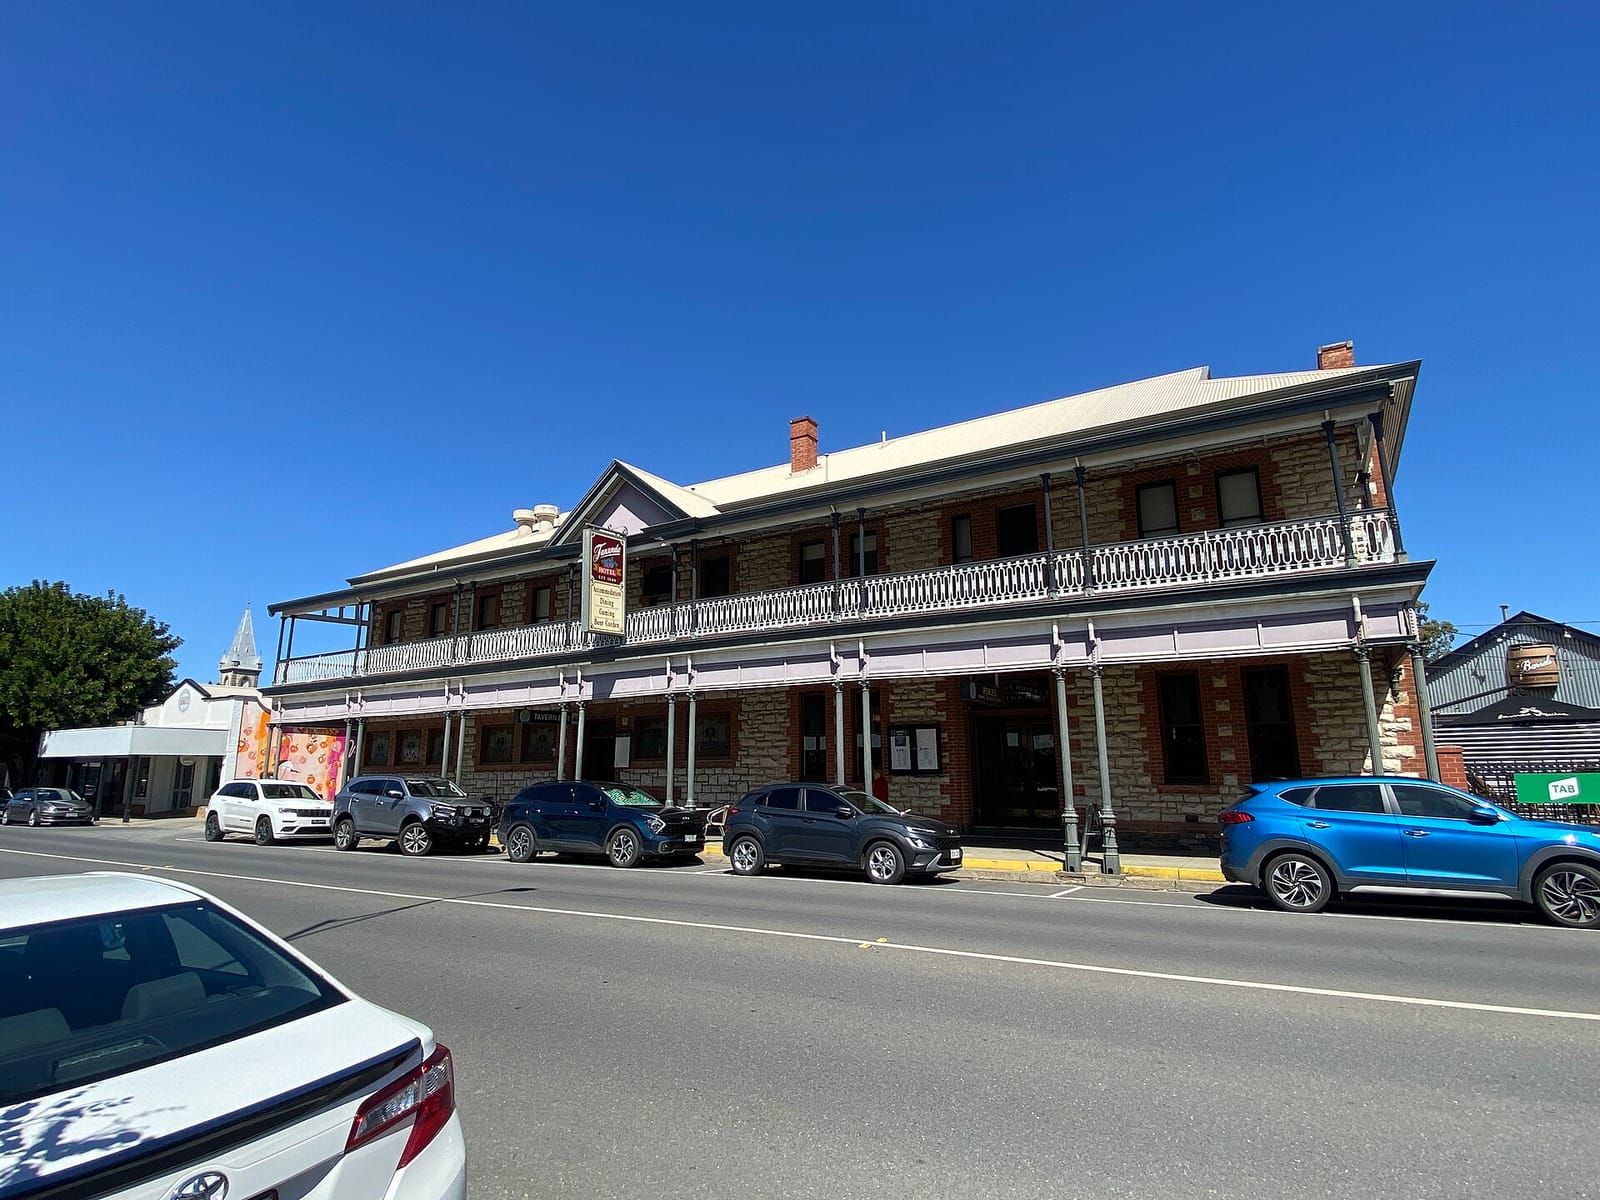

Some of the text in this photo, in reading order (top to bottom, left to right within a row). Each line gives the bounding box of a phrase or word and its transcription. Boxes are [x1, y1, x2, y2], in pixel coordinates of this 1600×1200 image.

[598, 566, 617, 576] HOTEL
[600, 597, 614, 608] Dining
[598, 608, 615, 618] Gaming
[534, 713, 557, 721] TAVERN
[1551, 784, 1576, 793] TAB
